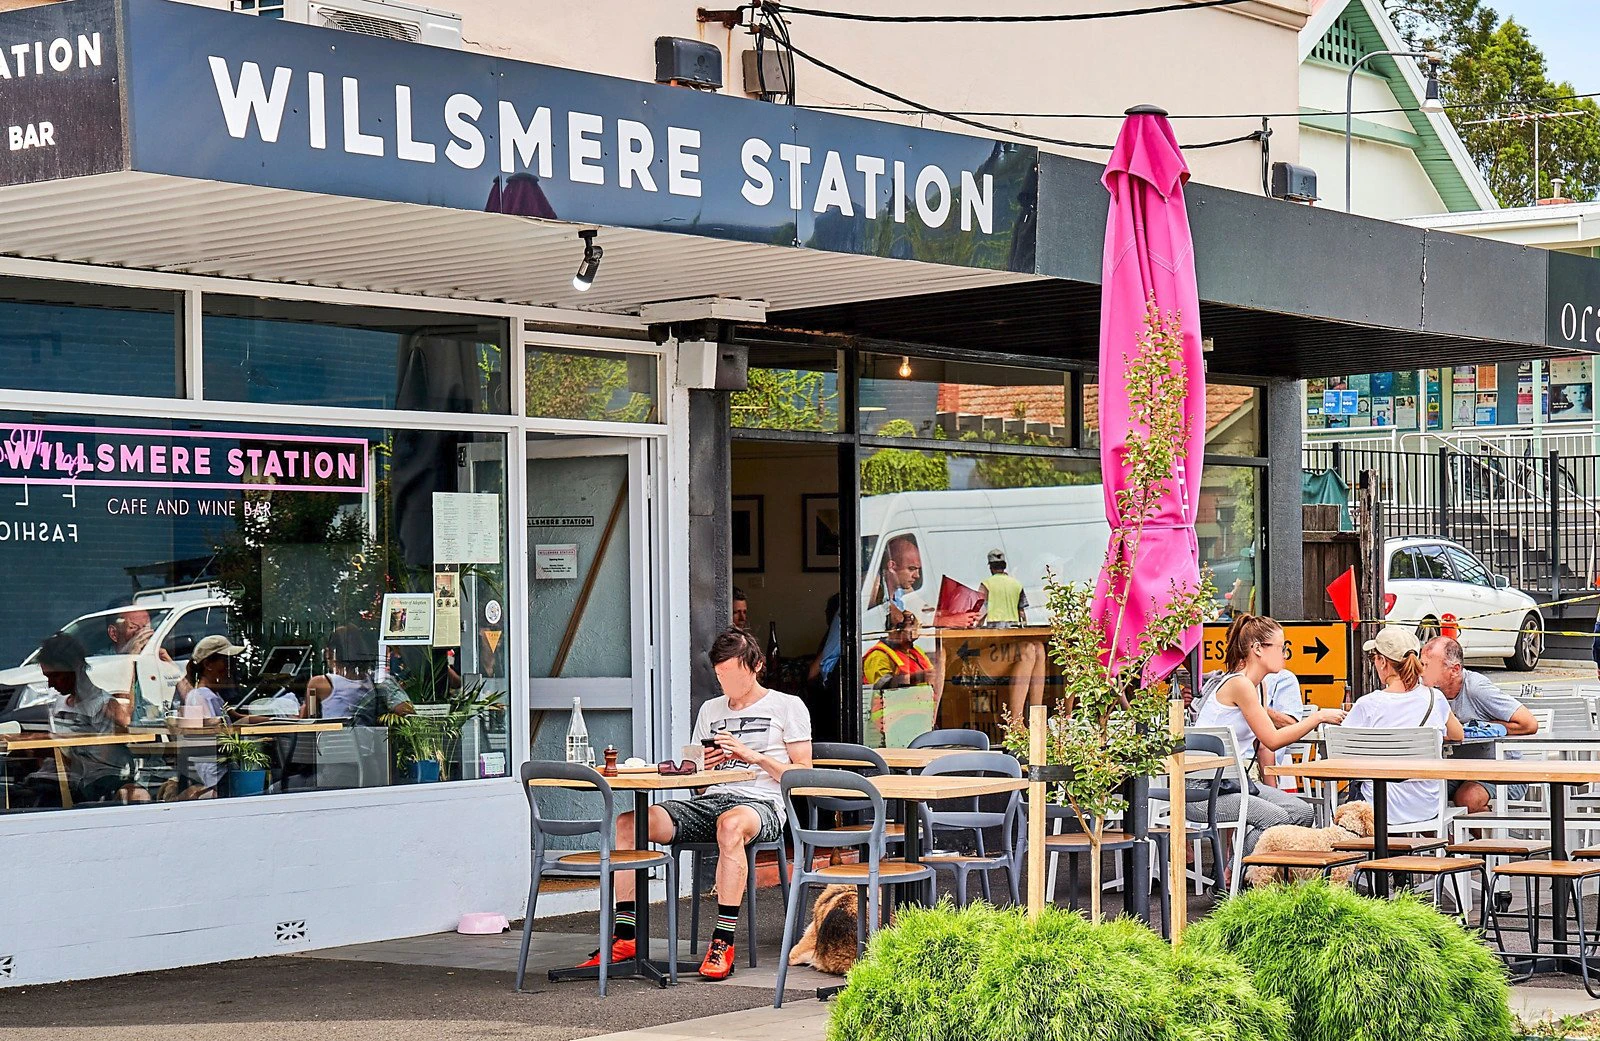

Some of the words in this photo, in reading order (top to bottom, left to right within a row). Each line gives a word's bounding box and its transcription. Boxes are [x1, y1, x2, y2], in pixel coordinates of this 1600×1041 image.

[8, 121, 55, 151] BAR
[207, 55, 702, 198] WILLSMERE
[741, 138, 994, 235] STATION
[4, 440, 211, 475] WILLSMERE
[227, 448, 356, 480] STATION
[107, 498, 147, 515] CAFE
[156, 499, 190, 516] AND
[197, 500, 236, 516] WINE
[244, 501, 272, 517] BAR
